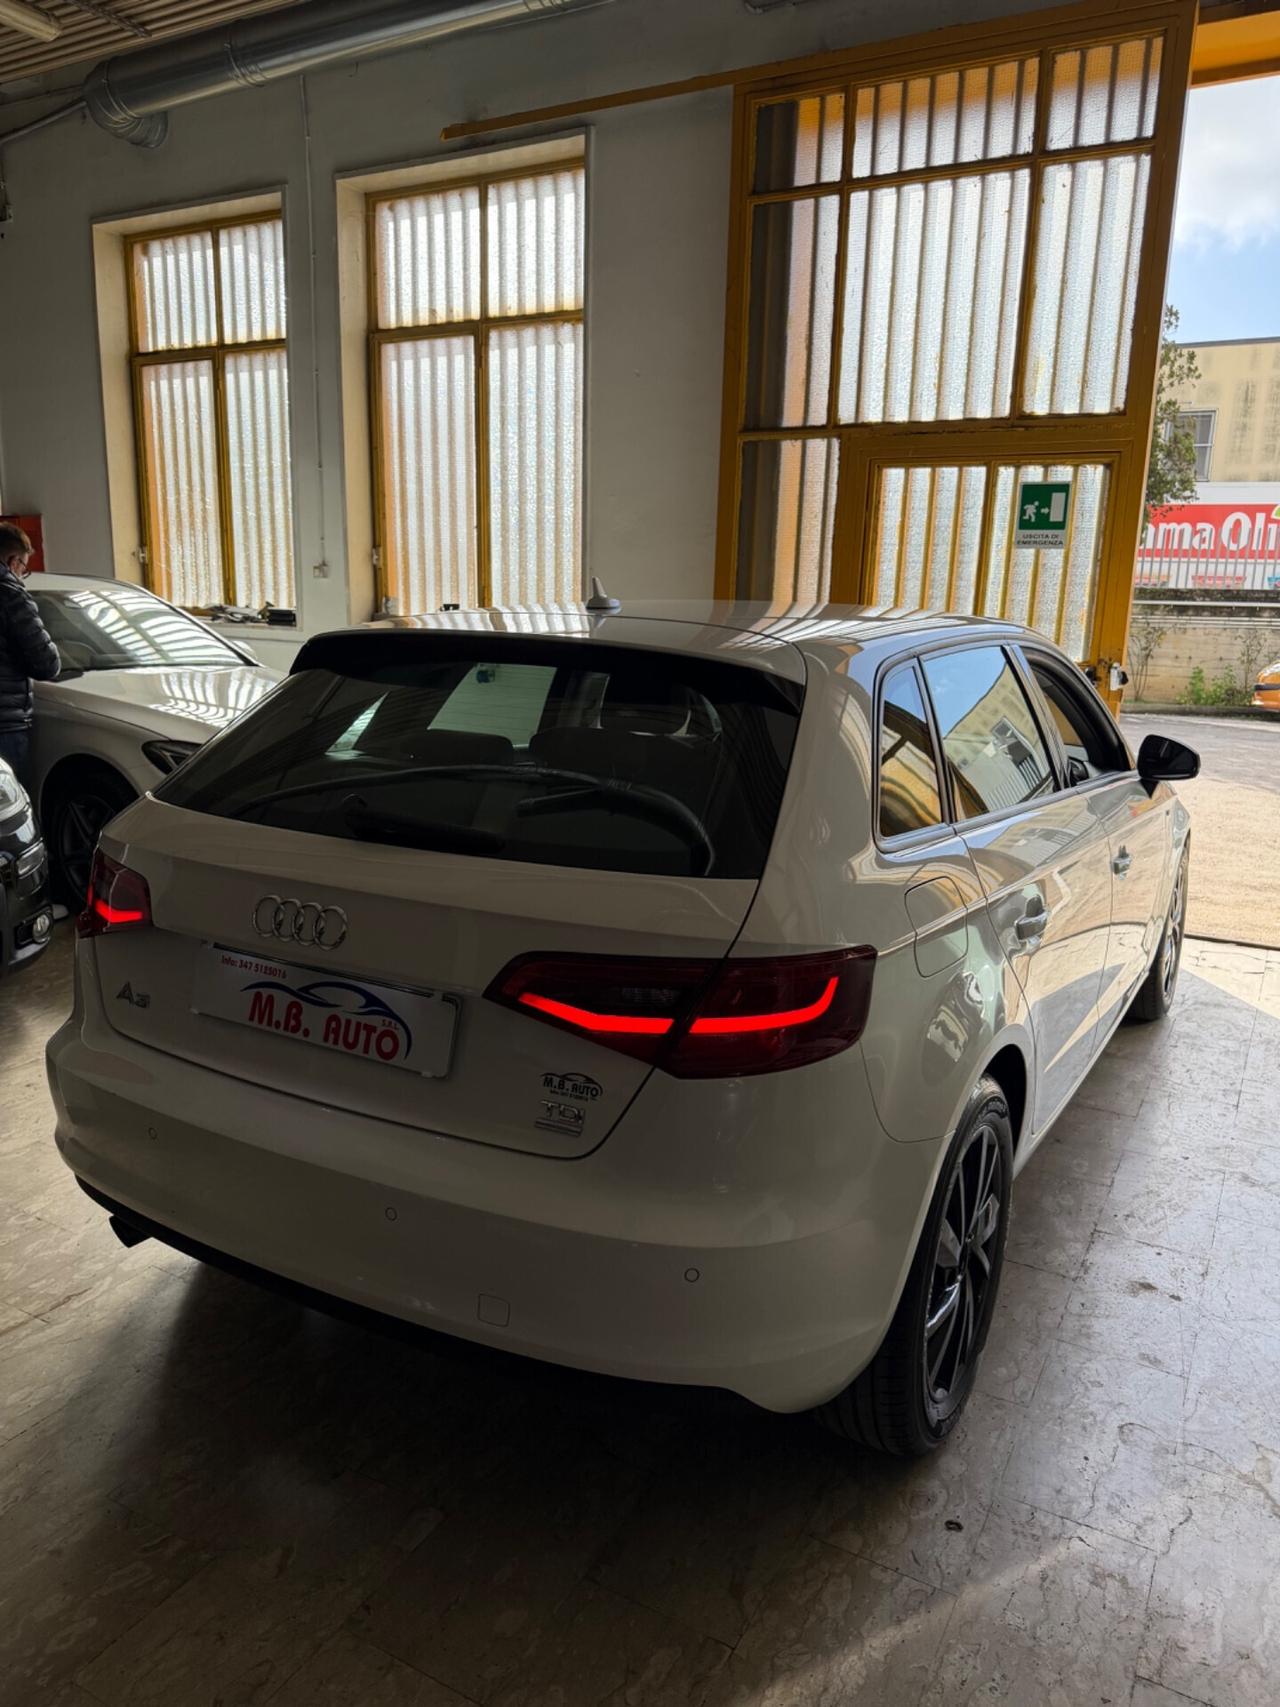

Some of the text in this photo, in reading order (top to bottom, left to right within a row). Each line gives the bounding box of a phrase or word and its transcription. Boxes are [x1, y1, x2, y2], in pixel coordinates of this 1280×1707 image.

[222, 955, 238, 967] Info:
[239, 959, 253, 970] 347
[249, 991, 400, 1061] M.B. AUTO
[544, 1076, 569, 1091] M.B.
[572, 1083, 598, 1097] AUTO
